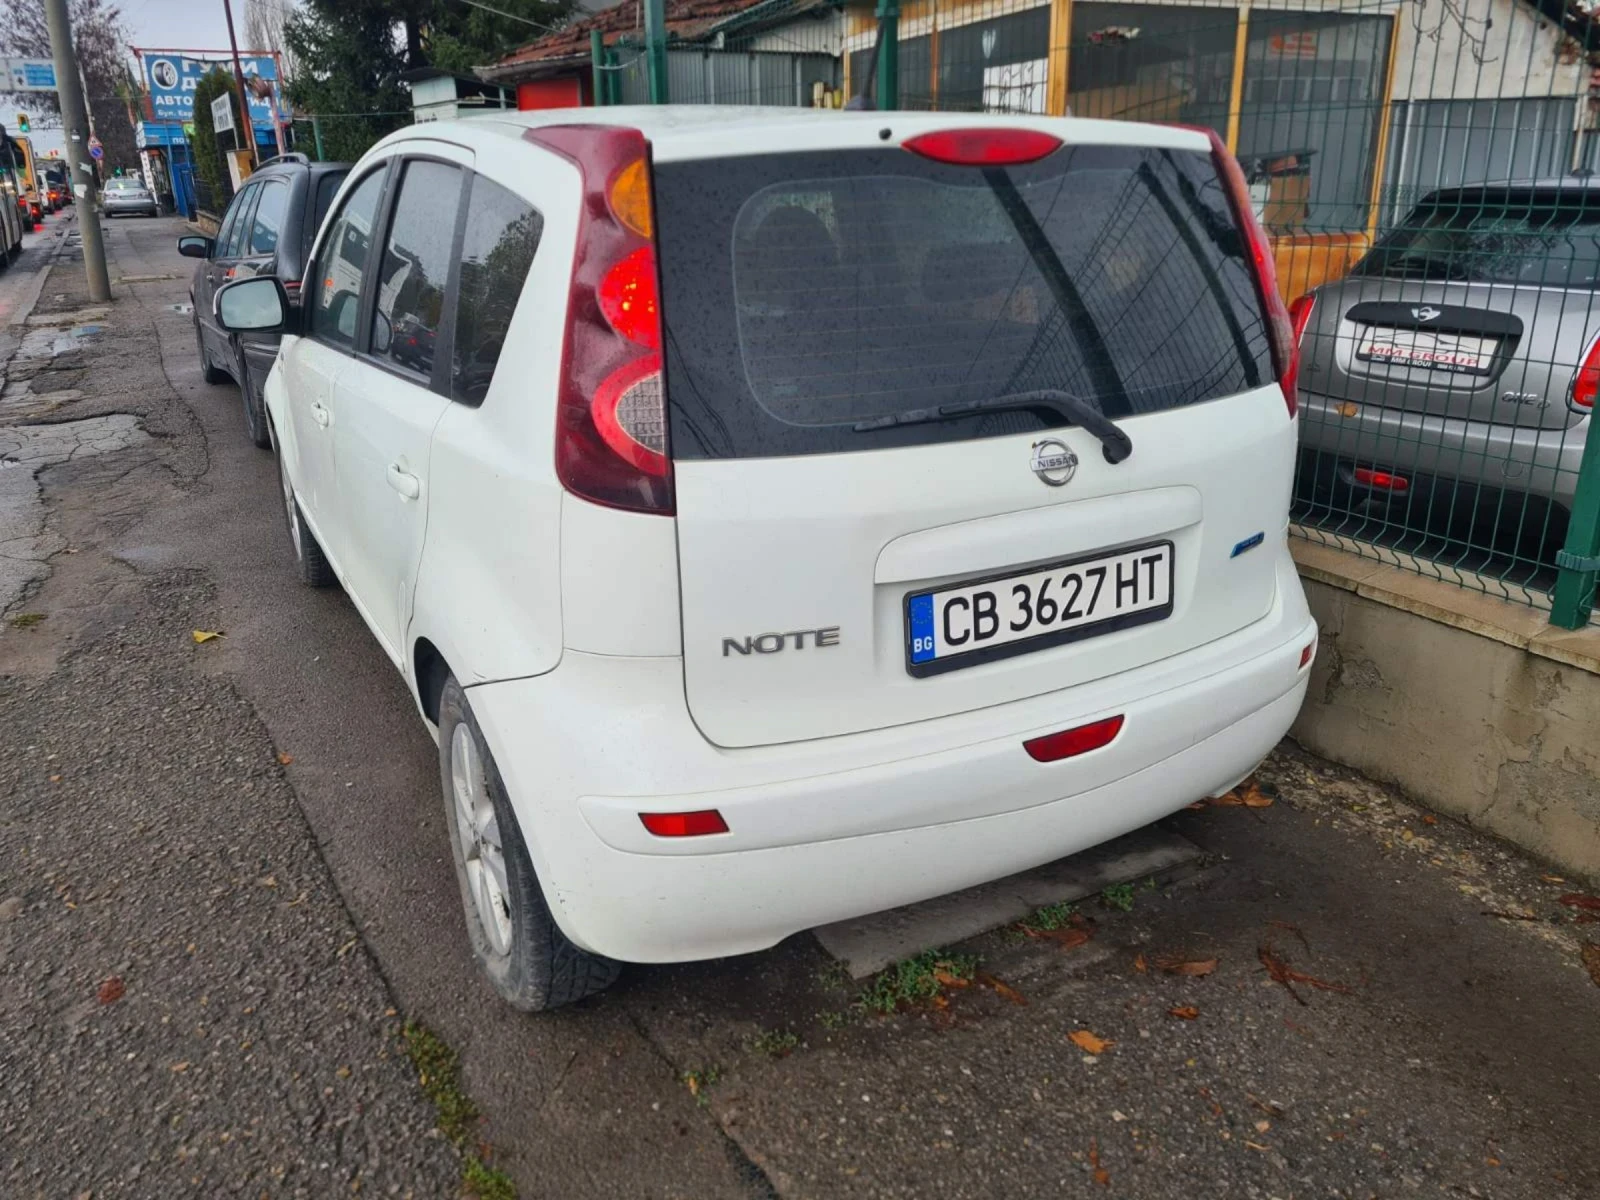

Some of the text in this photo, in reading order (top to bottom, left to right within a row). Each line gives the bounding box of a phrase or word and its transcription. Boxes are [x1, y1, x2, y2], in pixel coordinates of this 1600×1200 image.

[1038, 455, 1077, 468] NISSAN
[943, 553, 1163, 646] CB 3627 HT
[721, 625, 840, 657] NOTE
[913, 636, 933, 653] BG
